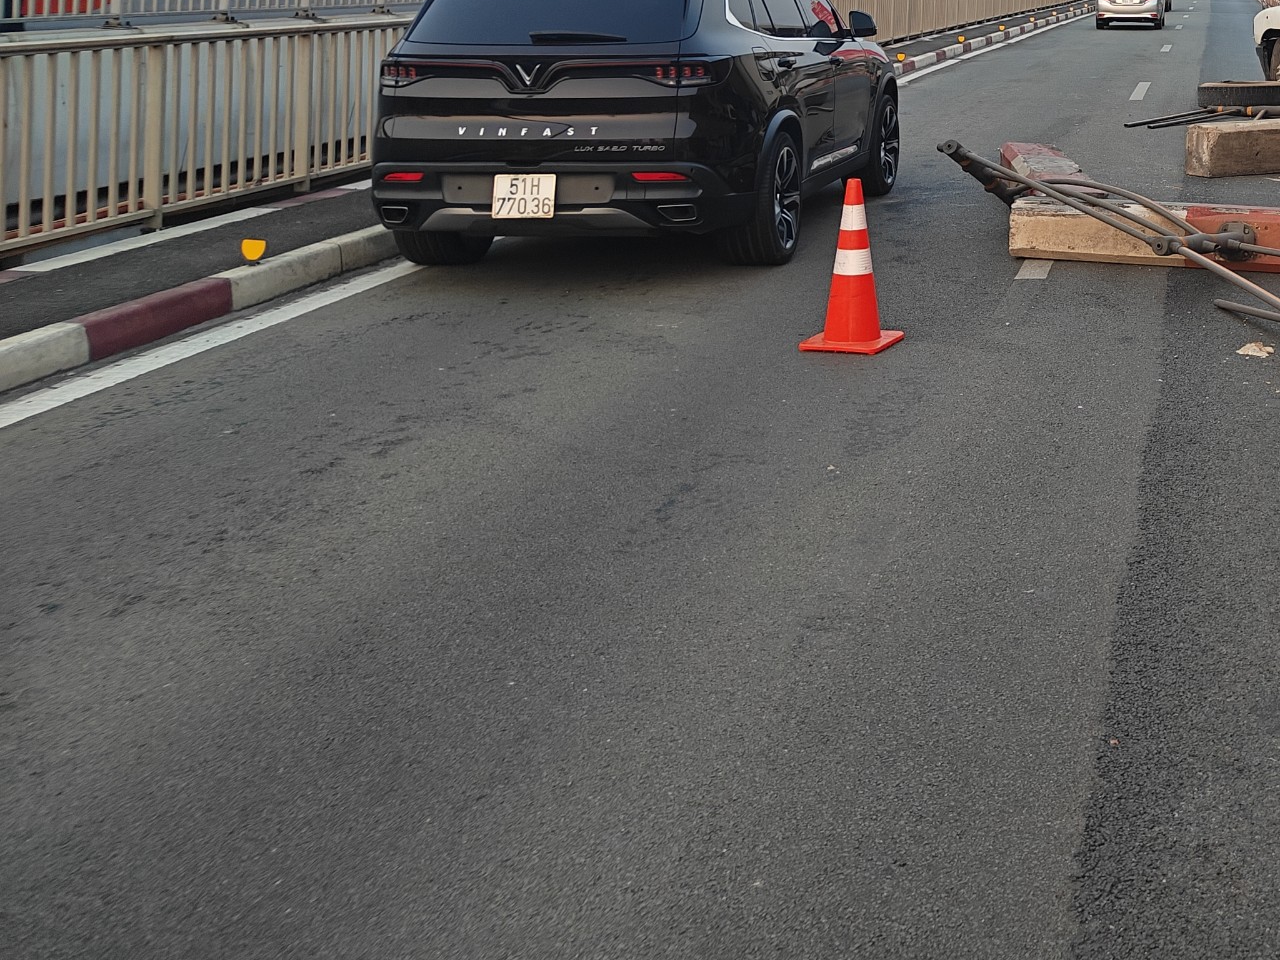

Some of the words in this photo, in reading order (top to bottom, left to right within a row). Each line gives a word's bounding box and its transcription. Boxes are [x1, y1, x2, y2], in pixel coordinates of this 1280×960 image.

[457, 125, 599, 137] VINFAST
[509, 177, 541, 195] 51H
[496, 197, 551, 215] 770.36
